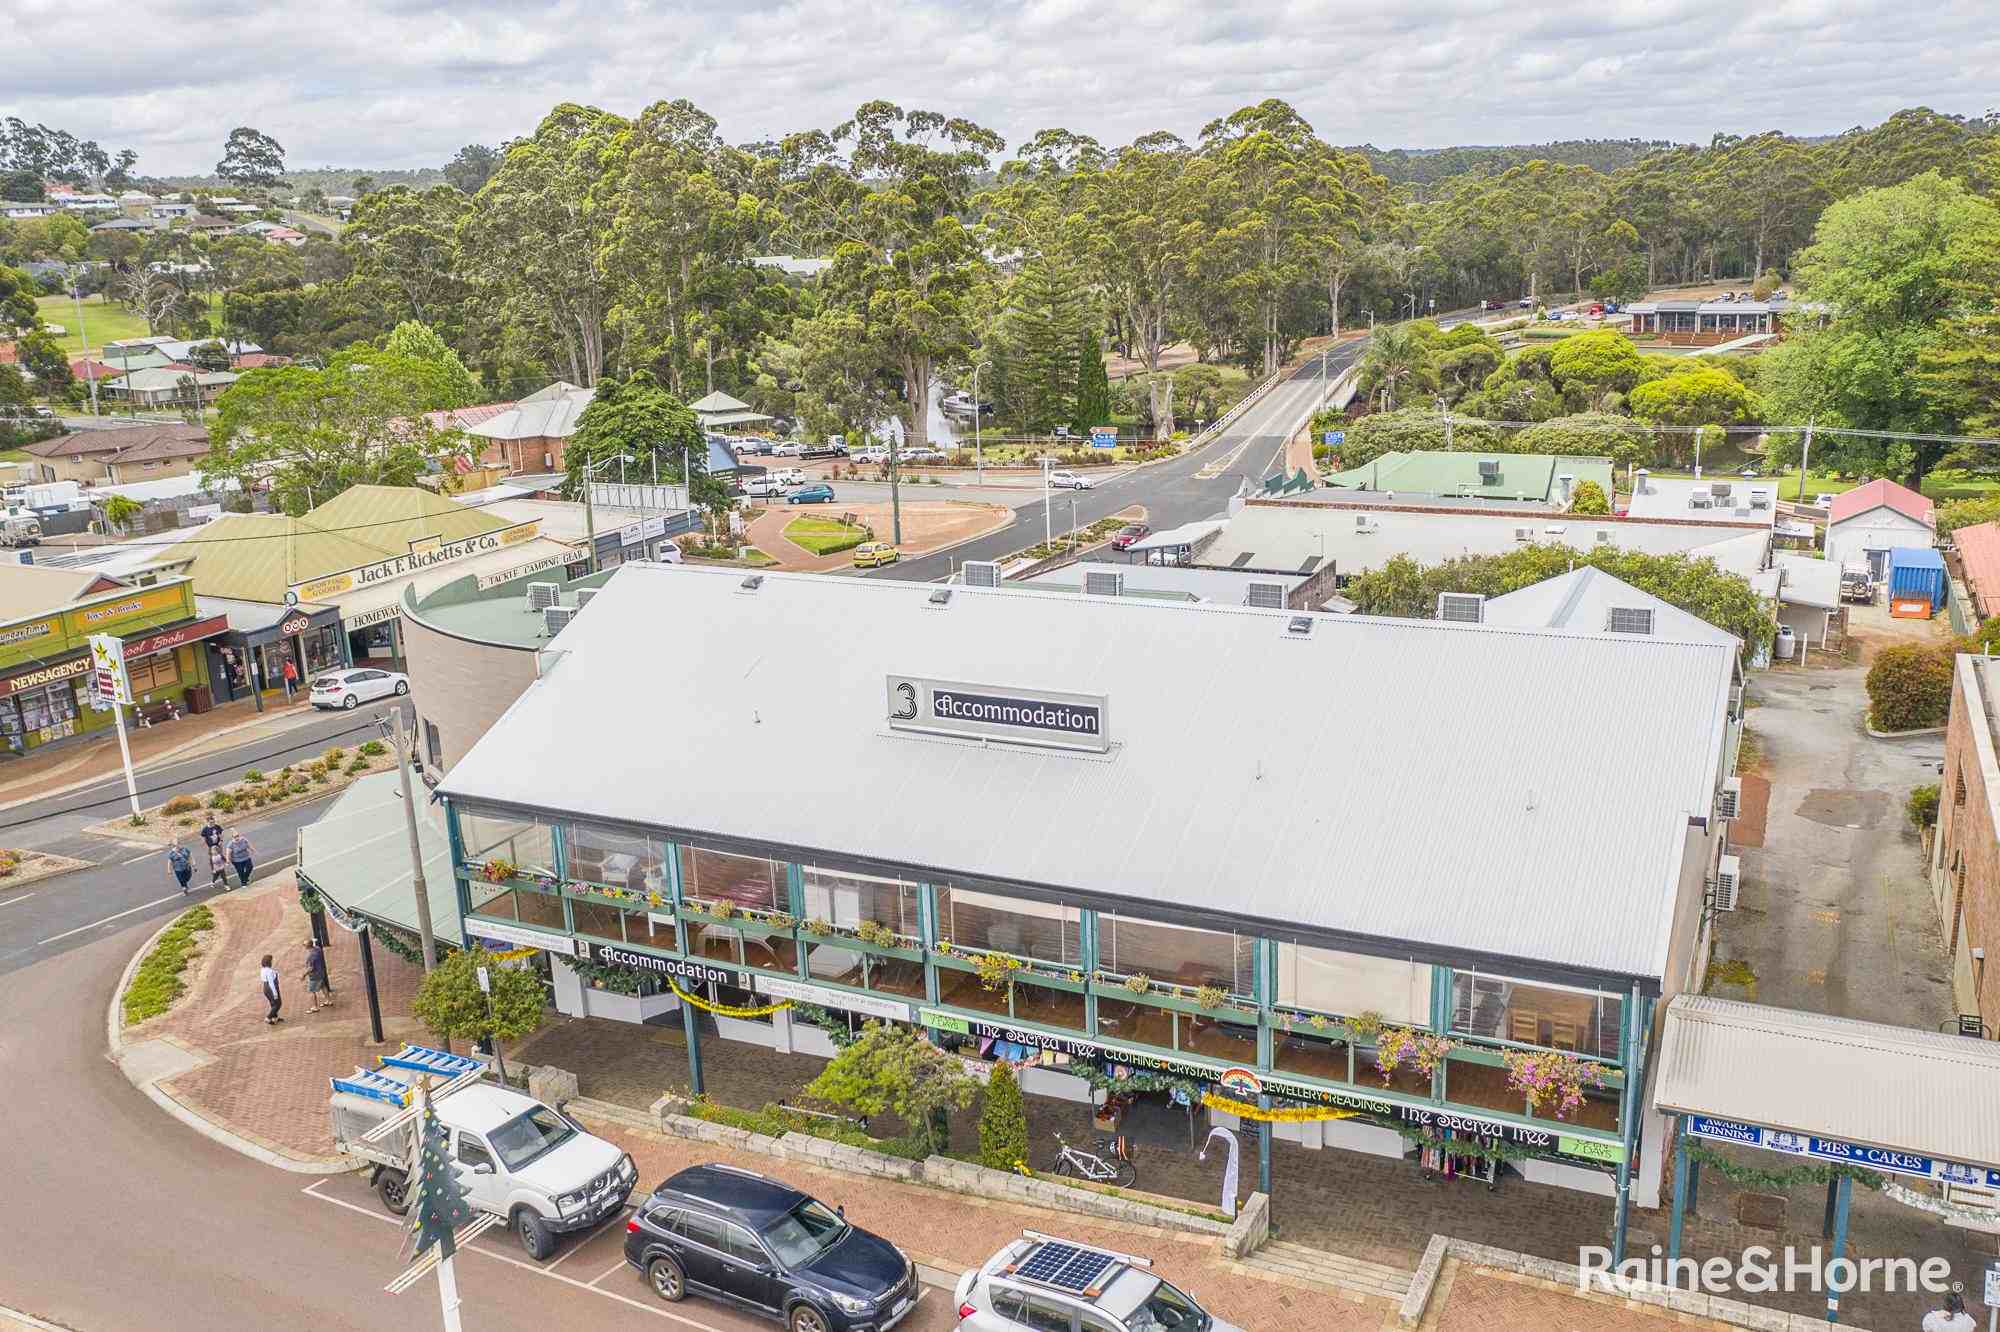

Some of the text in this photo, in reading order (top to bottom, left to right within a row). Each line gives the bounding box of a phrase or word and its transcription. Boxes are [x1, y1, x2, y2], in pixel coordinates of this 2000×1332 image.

[358, 562, 393, 584] Jack
[407, 543, 461, 570] Ricketts
[464, 540, 476, 554] &
[479, 535, 498, 549] Co.
[10, 658, 91, 691] NEWSAGENCY
[934, 694, 1097, 731] Accommodation
[599, 946, 728, 984] Accommodation
[976, 1022, 1096, 1058] The Sacred Tree
[1104, 1048, 1220, 1081] CLOTHING CRYSTALS
[1263, 1081, 1391, 1114] JEWELLERY READINGS
[1400, 1105, 1550, 1147] The Sacred Tree
[1699, 1123, 1755, 1141] WINNING
[1706, 1118, 1748, 1131] AWARD
[1818, 1140, 1850, 1156] PIES
[1868, 1149, 1922, 1169] CAKES
